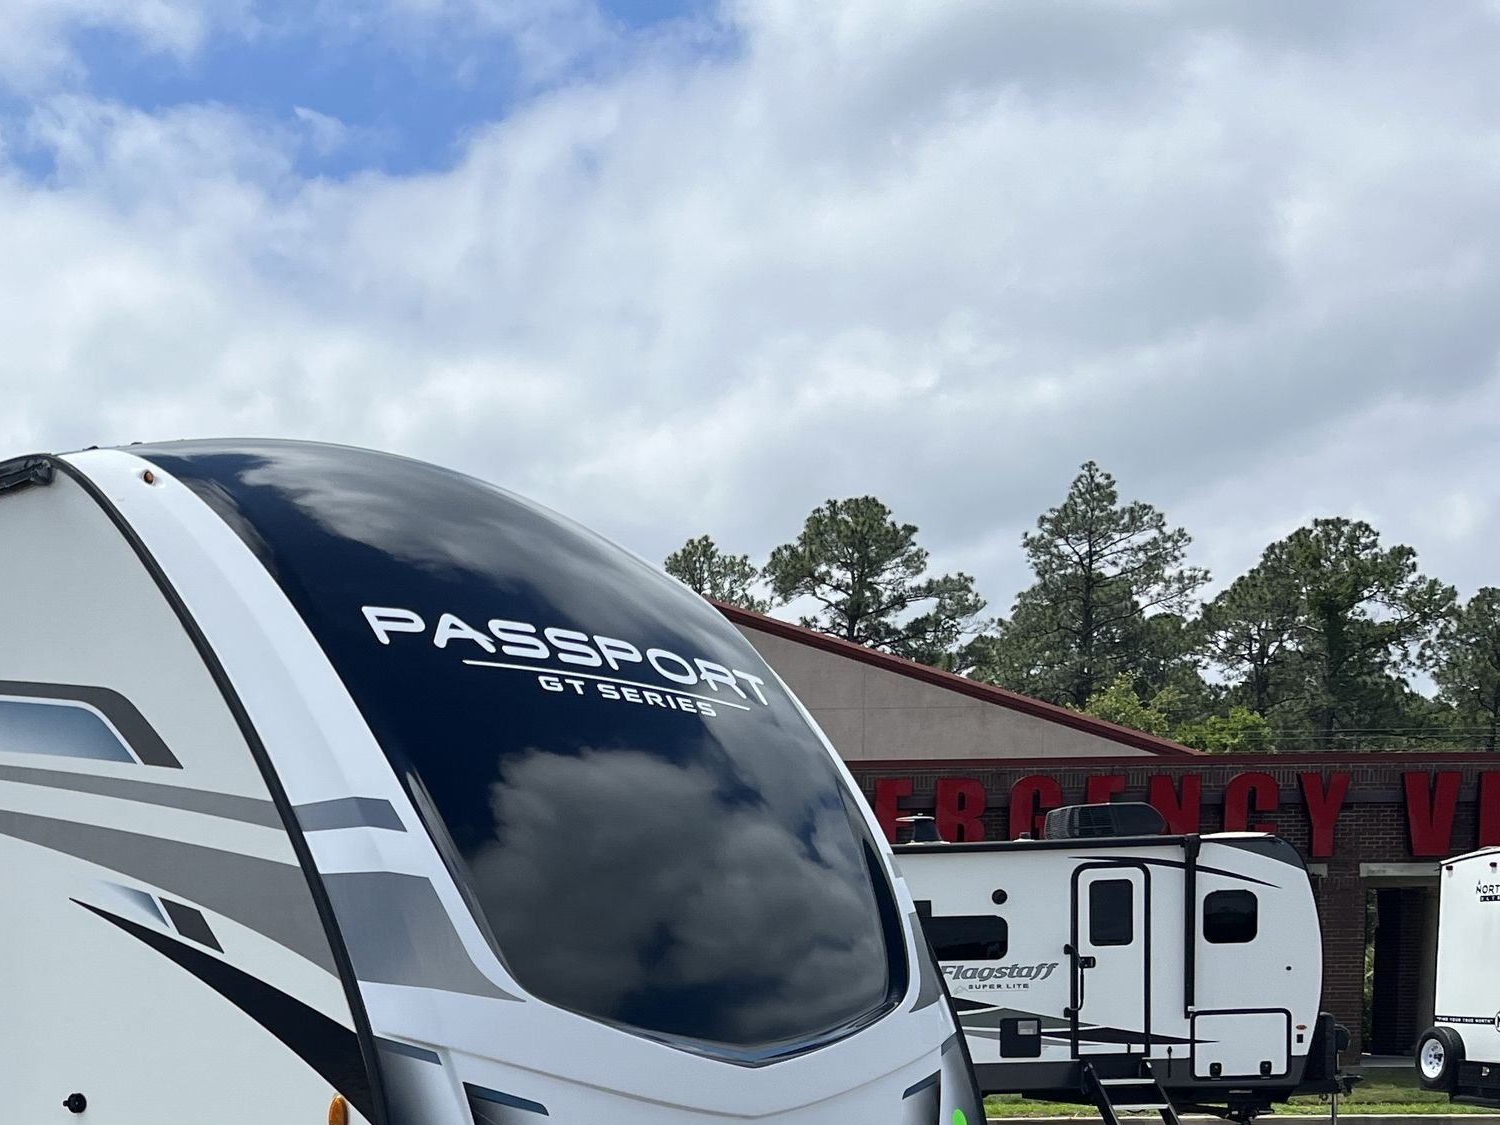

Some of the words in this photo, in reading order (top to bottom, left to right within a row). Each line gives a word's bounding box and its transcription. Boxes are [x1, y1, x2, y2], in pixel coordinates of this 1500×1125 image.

[361, 605, 765, 705] PASSPORT
[538, 675, 586, 695] GT
[597, 683, 717, 717] SERIES
[941, 963, 1059, 982] Flagstaff
